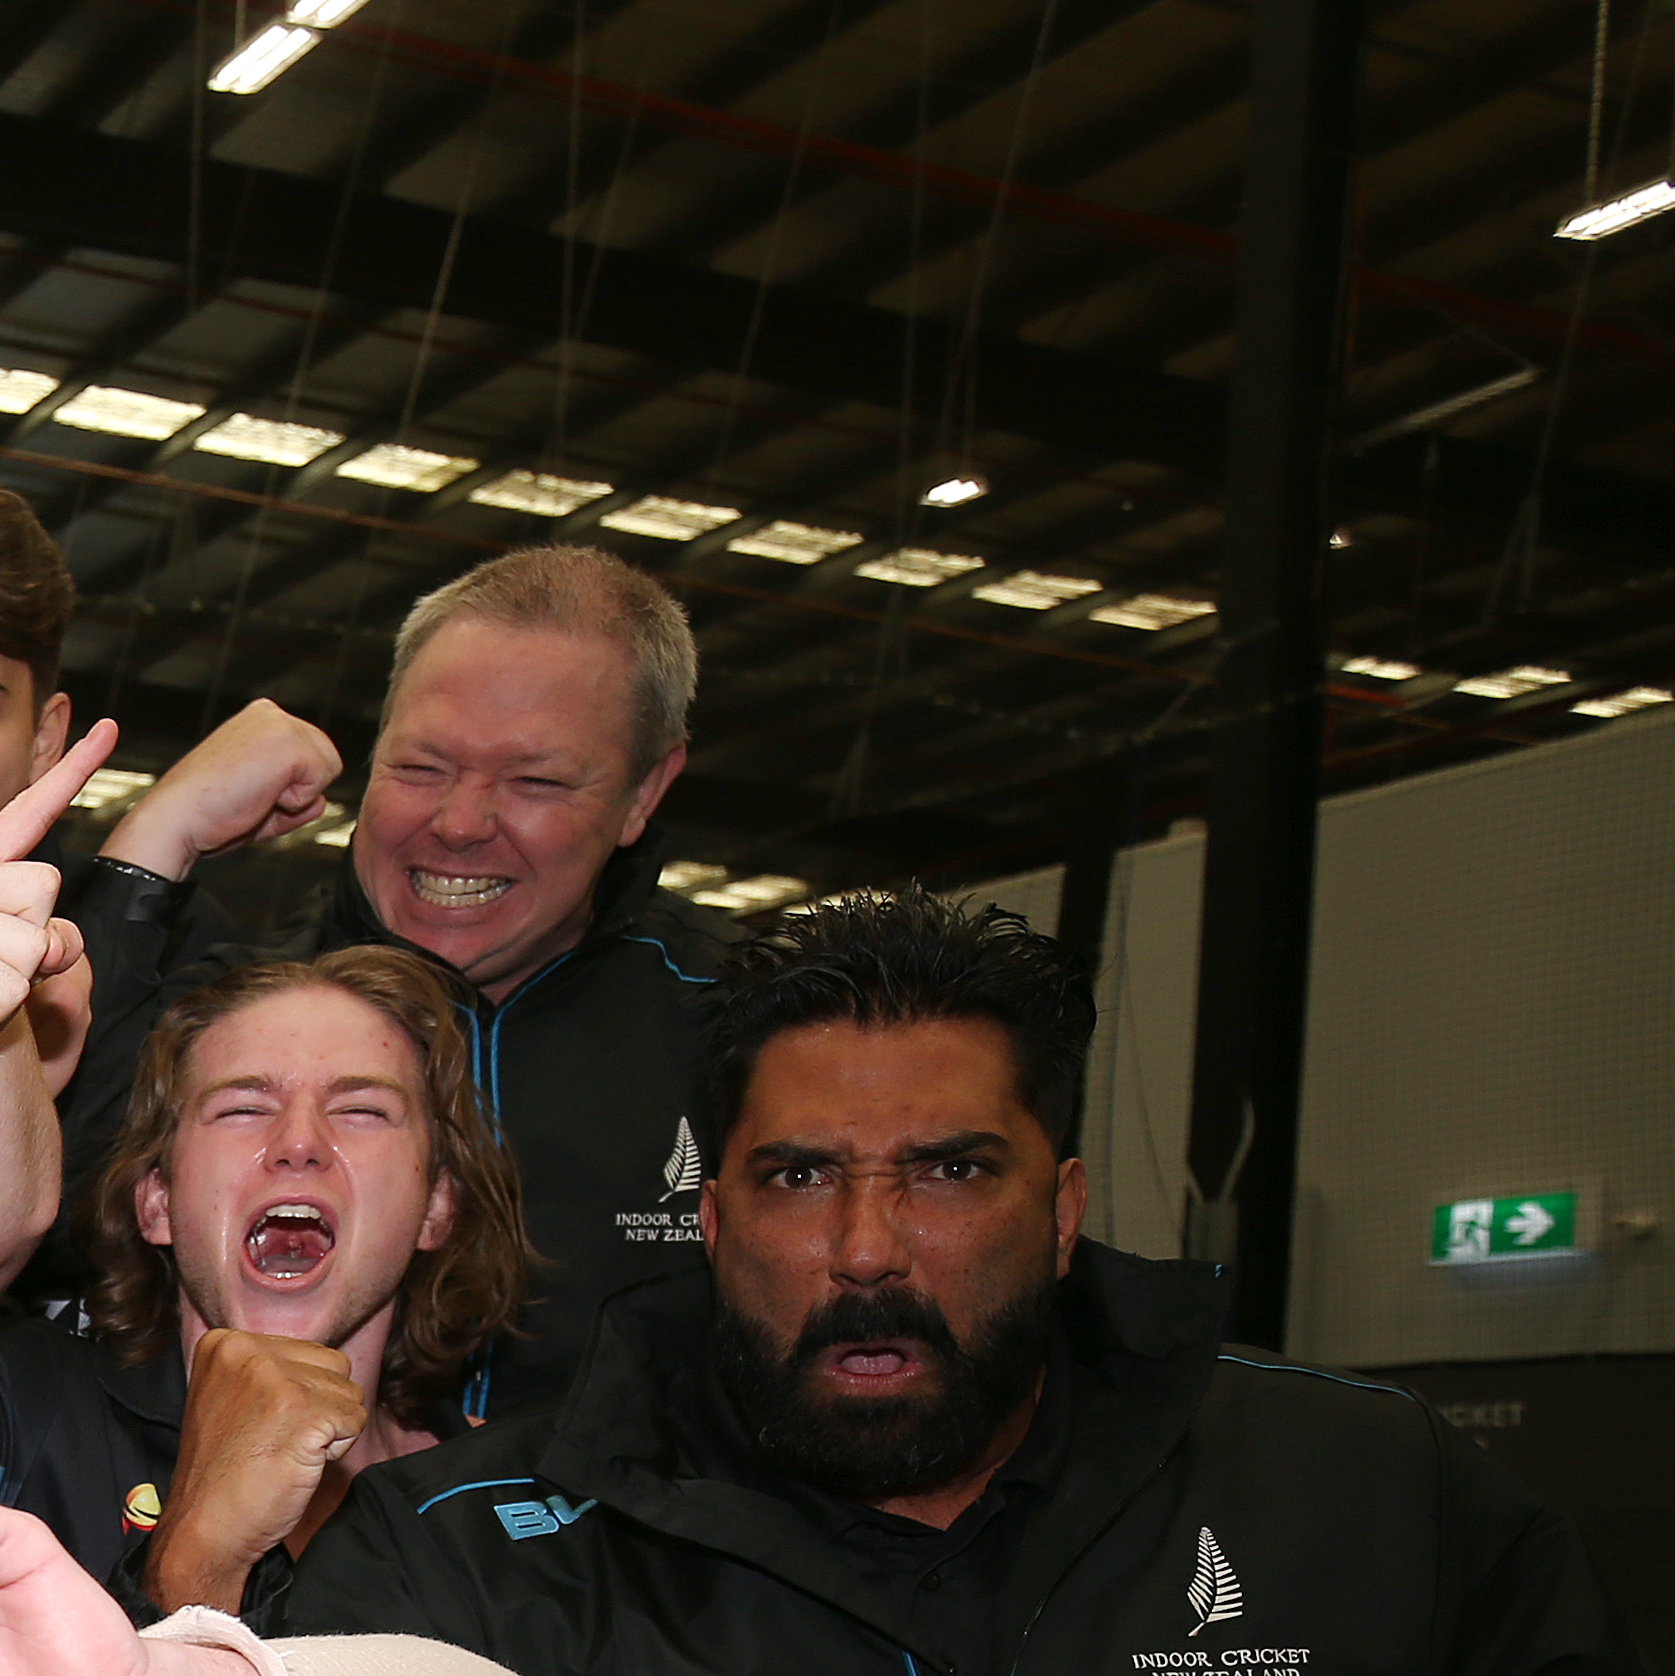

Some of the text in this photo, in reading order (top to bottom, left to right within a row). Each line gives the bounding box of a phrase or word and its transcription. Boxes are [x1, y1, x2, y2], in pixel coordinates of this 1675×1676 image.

[615, 1213, 673, 1227] INDOOR
[625, 1229, 660, 1241] NEW
[1131, 1647, 1311, 1670] INDOOR CRICKET
